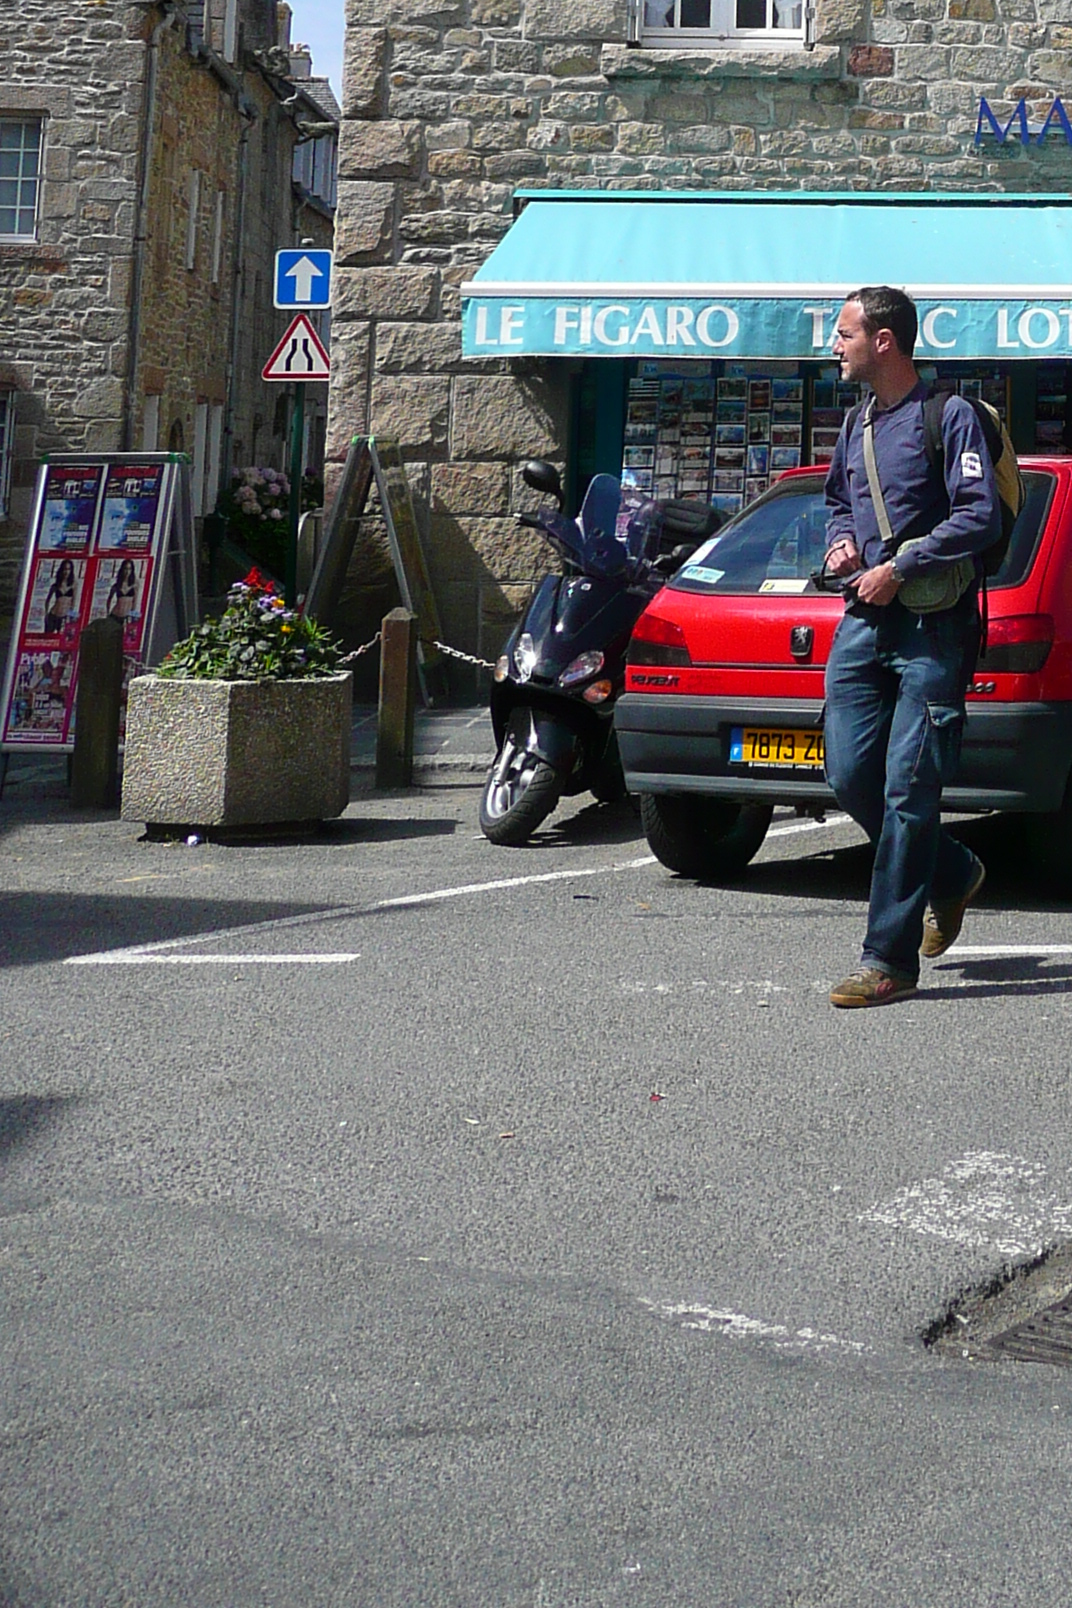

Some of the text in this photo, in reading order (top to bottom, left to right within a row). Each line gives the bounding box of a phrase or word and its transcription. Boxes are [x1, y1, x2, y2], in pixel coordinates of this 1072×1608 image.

[475, 306, 525, 345] LE
[553, 305, 739, 347] FIGARO
[747, 733, 795, 759] 7873
